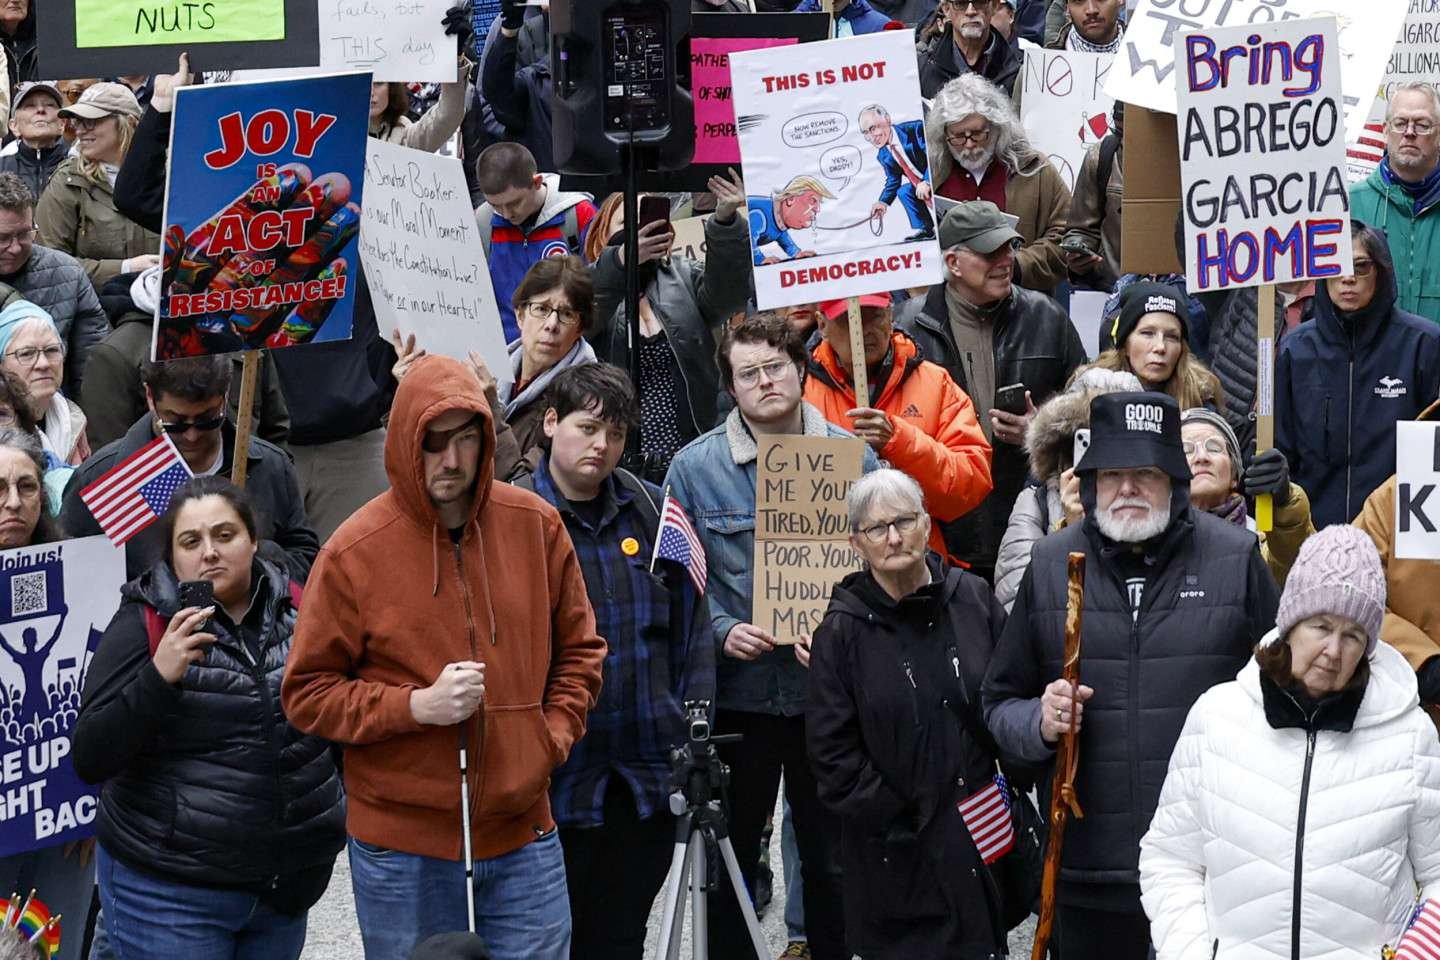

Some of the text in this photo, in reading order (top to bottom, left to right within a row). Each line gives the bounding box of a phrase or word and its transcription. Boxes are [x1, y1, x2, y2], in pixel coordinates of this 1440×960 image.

[135, 3, 216, 35] NUTS
[762, 61, 887, 93] THIS IS NOT
[1186, 33, 1324, 98] Bring
[203, 108, 338, 170] JOY
[1182, 97, 1338, 161] ABREGO
[256, 162, 278, 179] IS
[251, 186, 281, 204] AN
[1186, 166, 1349, 228] GARCIA
[207, 206, 315, 257] ACT
[250, 259, 277, 276] OF
[780, 251, 923, 289] DEMOCRACY!
[1196, 219, 1345, 289] HOME
[170, 276, 347, 318] RESISTANCE!
[1125, 404, 1163, 422] GOOD
[764, 443, 834, 472] GIVE
[765, 478, 795, 502] ME
[34, 544, 63, 564] us!
[1180, 590, 1204, 598] ororo
[28, 736, 71, 774] UP
